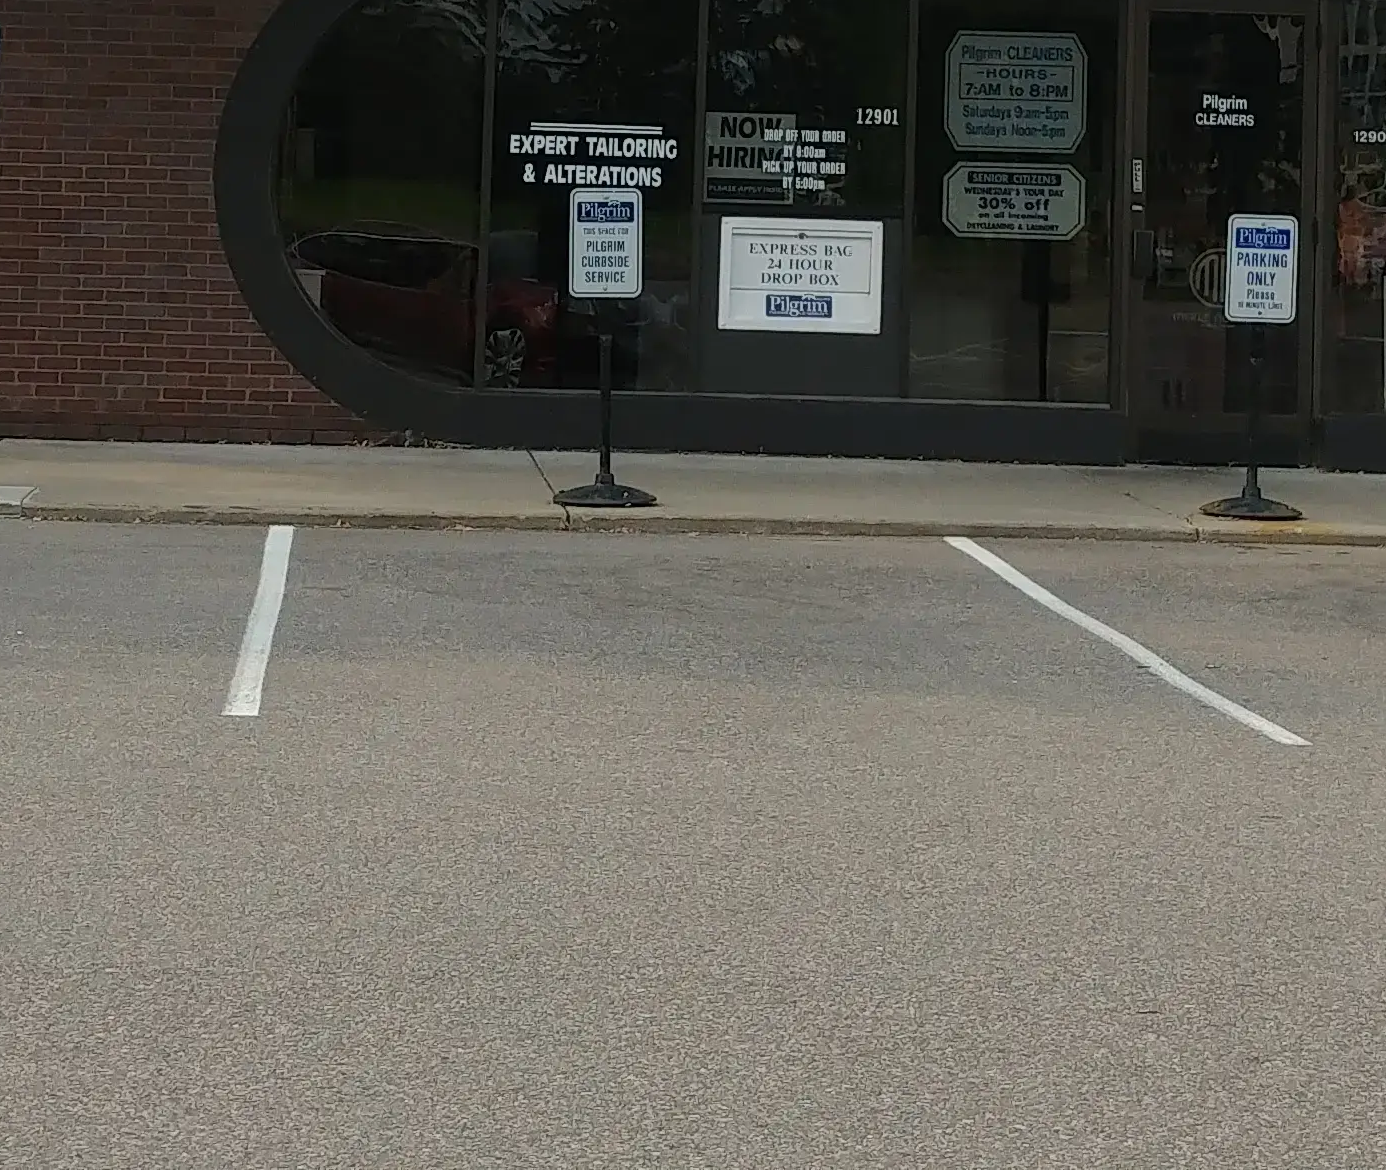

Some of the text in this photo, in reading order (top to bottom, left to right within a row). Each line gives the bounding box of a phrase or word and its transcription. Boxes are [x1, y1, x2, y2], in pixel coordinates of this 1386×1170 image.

[961, 45, 1073, 61] Pilgrim CLEANERS
[965, 83, 1068, 97] 7:AM to 8:PM
[1202, 94, 1248, 112] Pilgrim
[856, 108, 899, 126] 12901
[962, 105, 1012, 120] Saturdays
[1195, 112, 1255, 127] CLEANERS
[764, 129, 846, 143] DROP OFF YOUR ORDER
[965, 122, 1006, 137] Sundays
[509, 134, 677, 159] EXPERT TAILORING
[783, 145, 794, 158] BY
[762, 160, 846, 174] PICK UP YOUR ORDER
[523, 163, 662, 187] & ALTERATIONS
[973, 173, 1057, 184] SENIOR CITIZENS
[782, 176, 825, 192] BY 5:00pm
[978, 197, 1050, 210] 30% off
[581, 203, 631, 221] Pilgrim
[1239, 228, 1288, 248] Pilgrim
[586, 240, 625, 252] PILGRIM
[749, 243, 853, 257] EXPRESS BAG
[581, 255, 630, 268] CURBSIDE
[767, 258, 833, 271] 24 HOUR
[1237, 252, 1288, 268] PARKING
[584, 271, 626, 283] SERVICE
[761, 272, 840, 286] DROP BOX
[1246, 271, 1276, 286] ONLY
[1246, 288, 1275, 300] Please
[769, 295, 828, 316] Pilgrim
